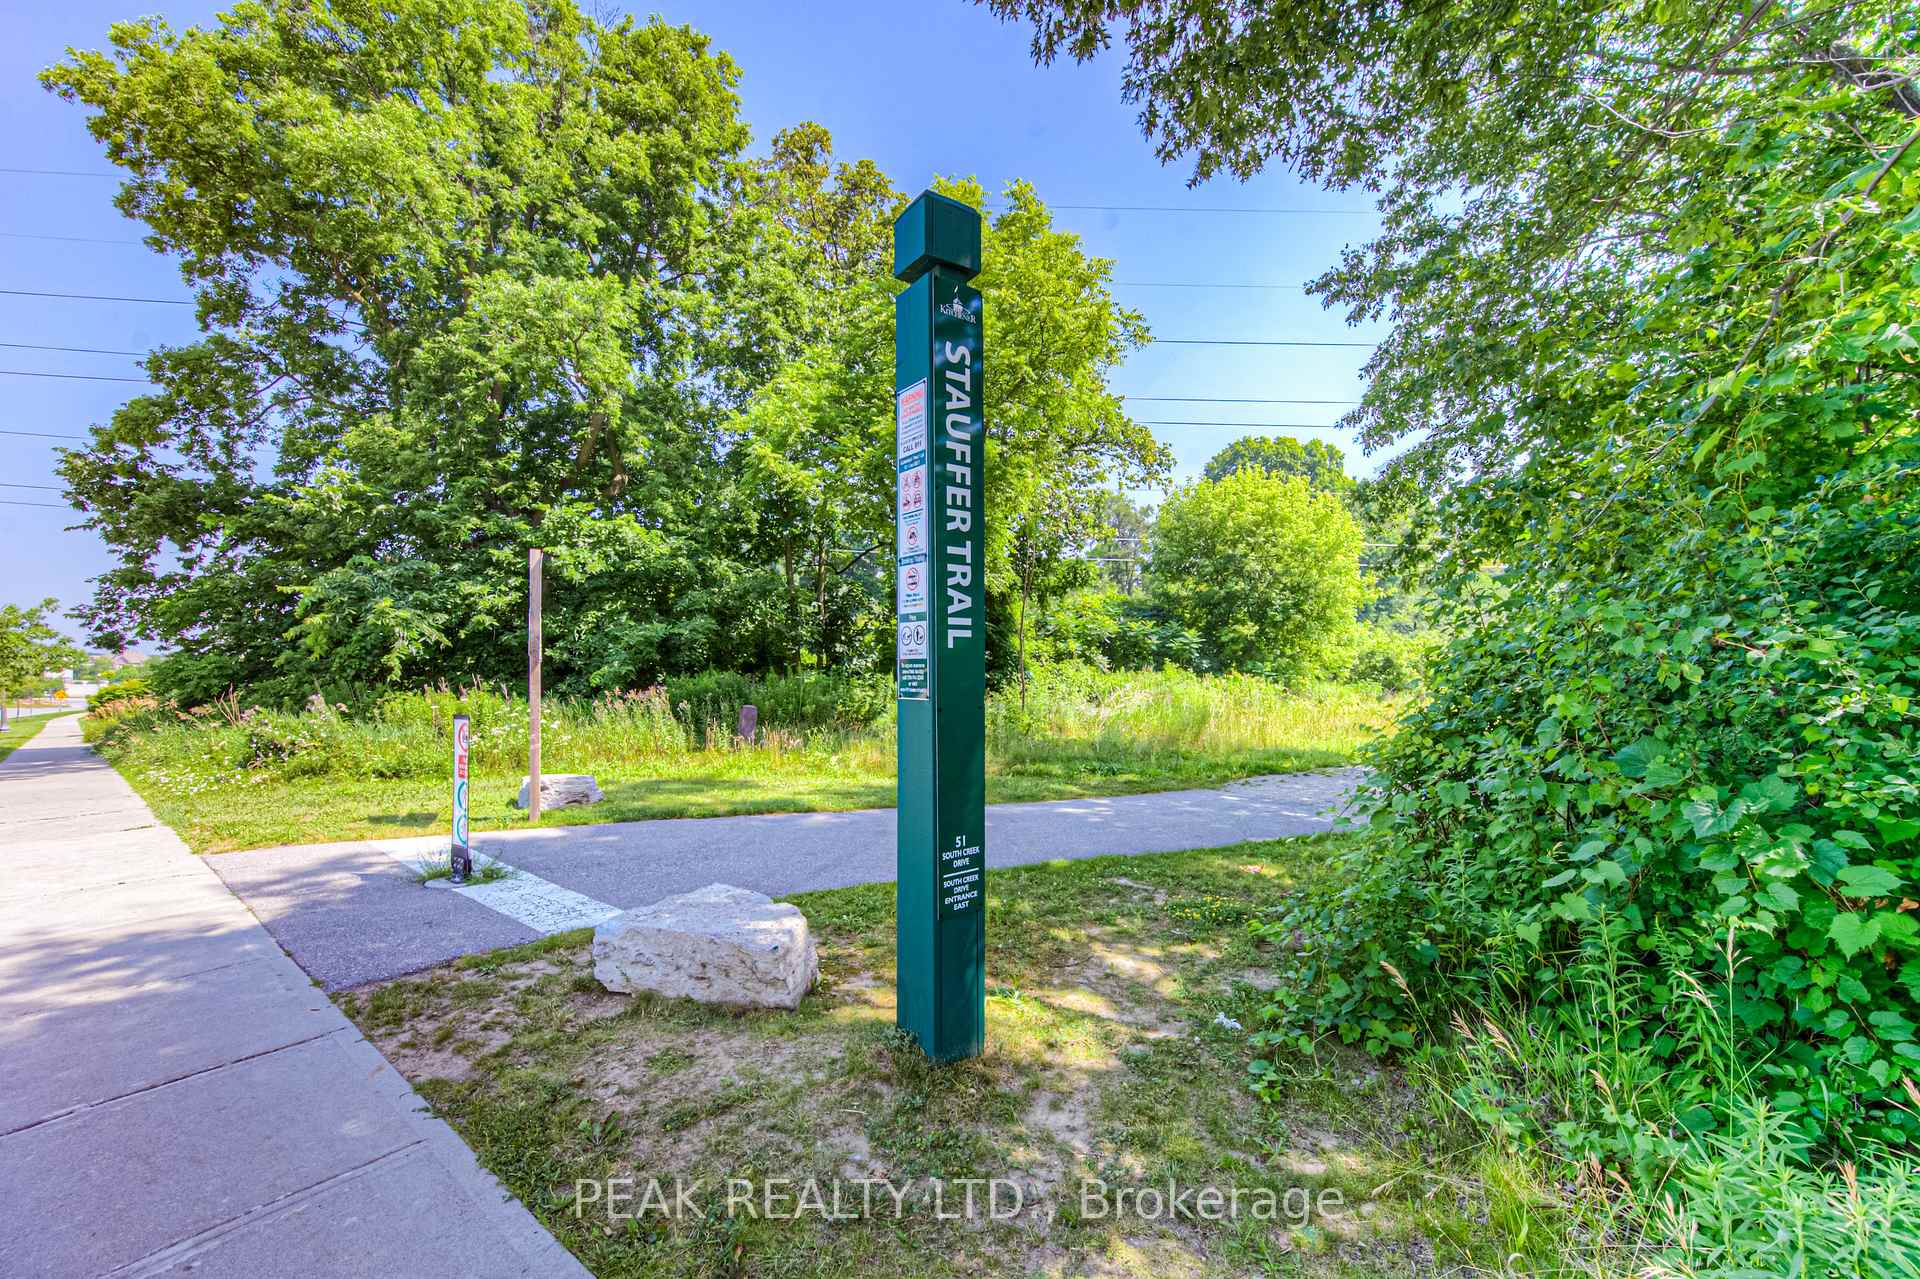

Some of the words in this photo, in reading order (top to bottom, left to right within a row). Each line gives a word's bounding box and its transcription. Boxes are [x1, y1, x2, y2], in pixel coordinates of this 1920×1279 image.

[945, 341, 972, 531] STAUFFER
[903, 443, 914, 453] CALL
[947, 541, 973, 649] TRAIL
[955, 835, 966, 848] 51
[942, 850, 962, 860] SOUTH
[963, 846, 980, 855] CREEK
[953, 857, 970, 868] DRIVE
[943, 879, 962, 888] SOUTH
[963, 874, 979, 883] CREEK
[953, 884, 969, 894] DRIVE
[945, 890, 978, 904] ENTRANCE
[953, 900, 969, 911] EAST
